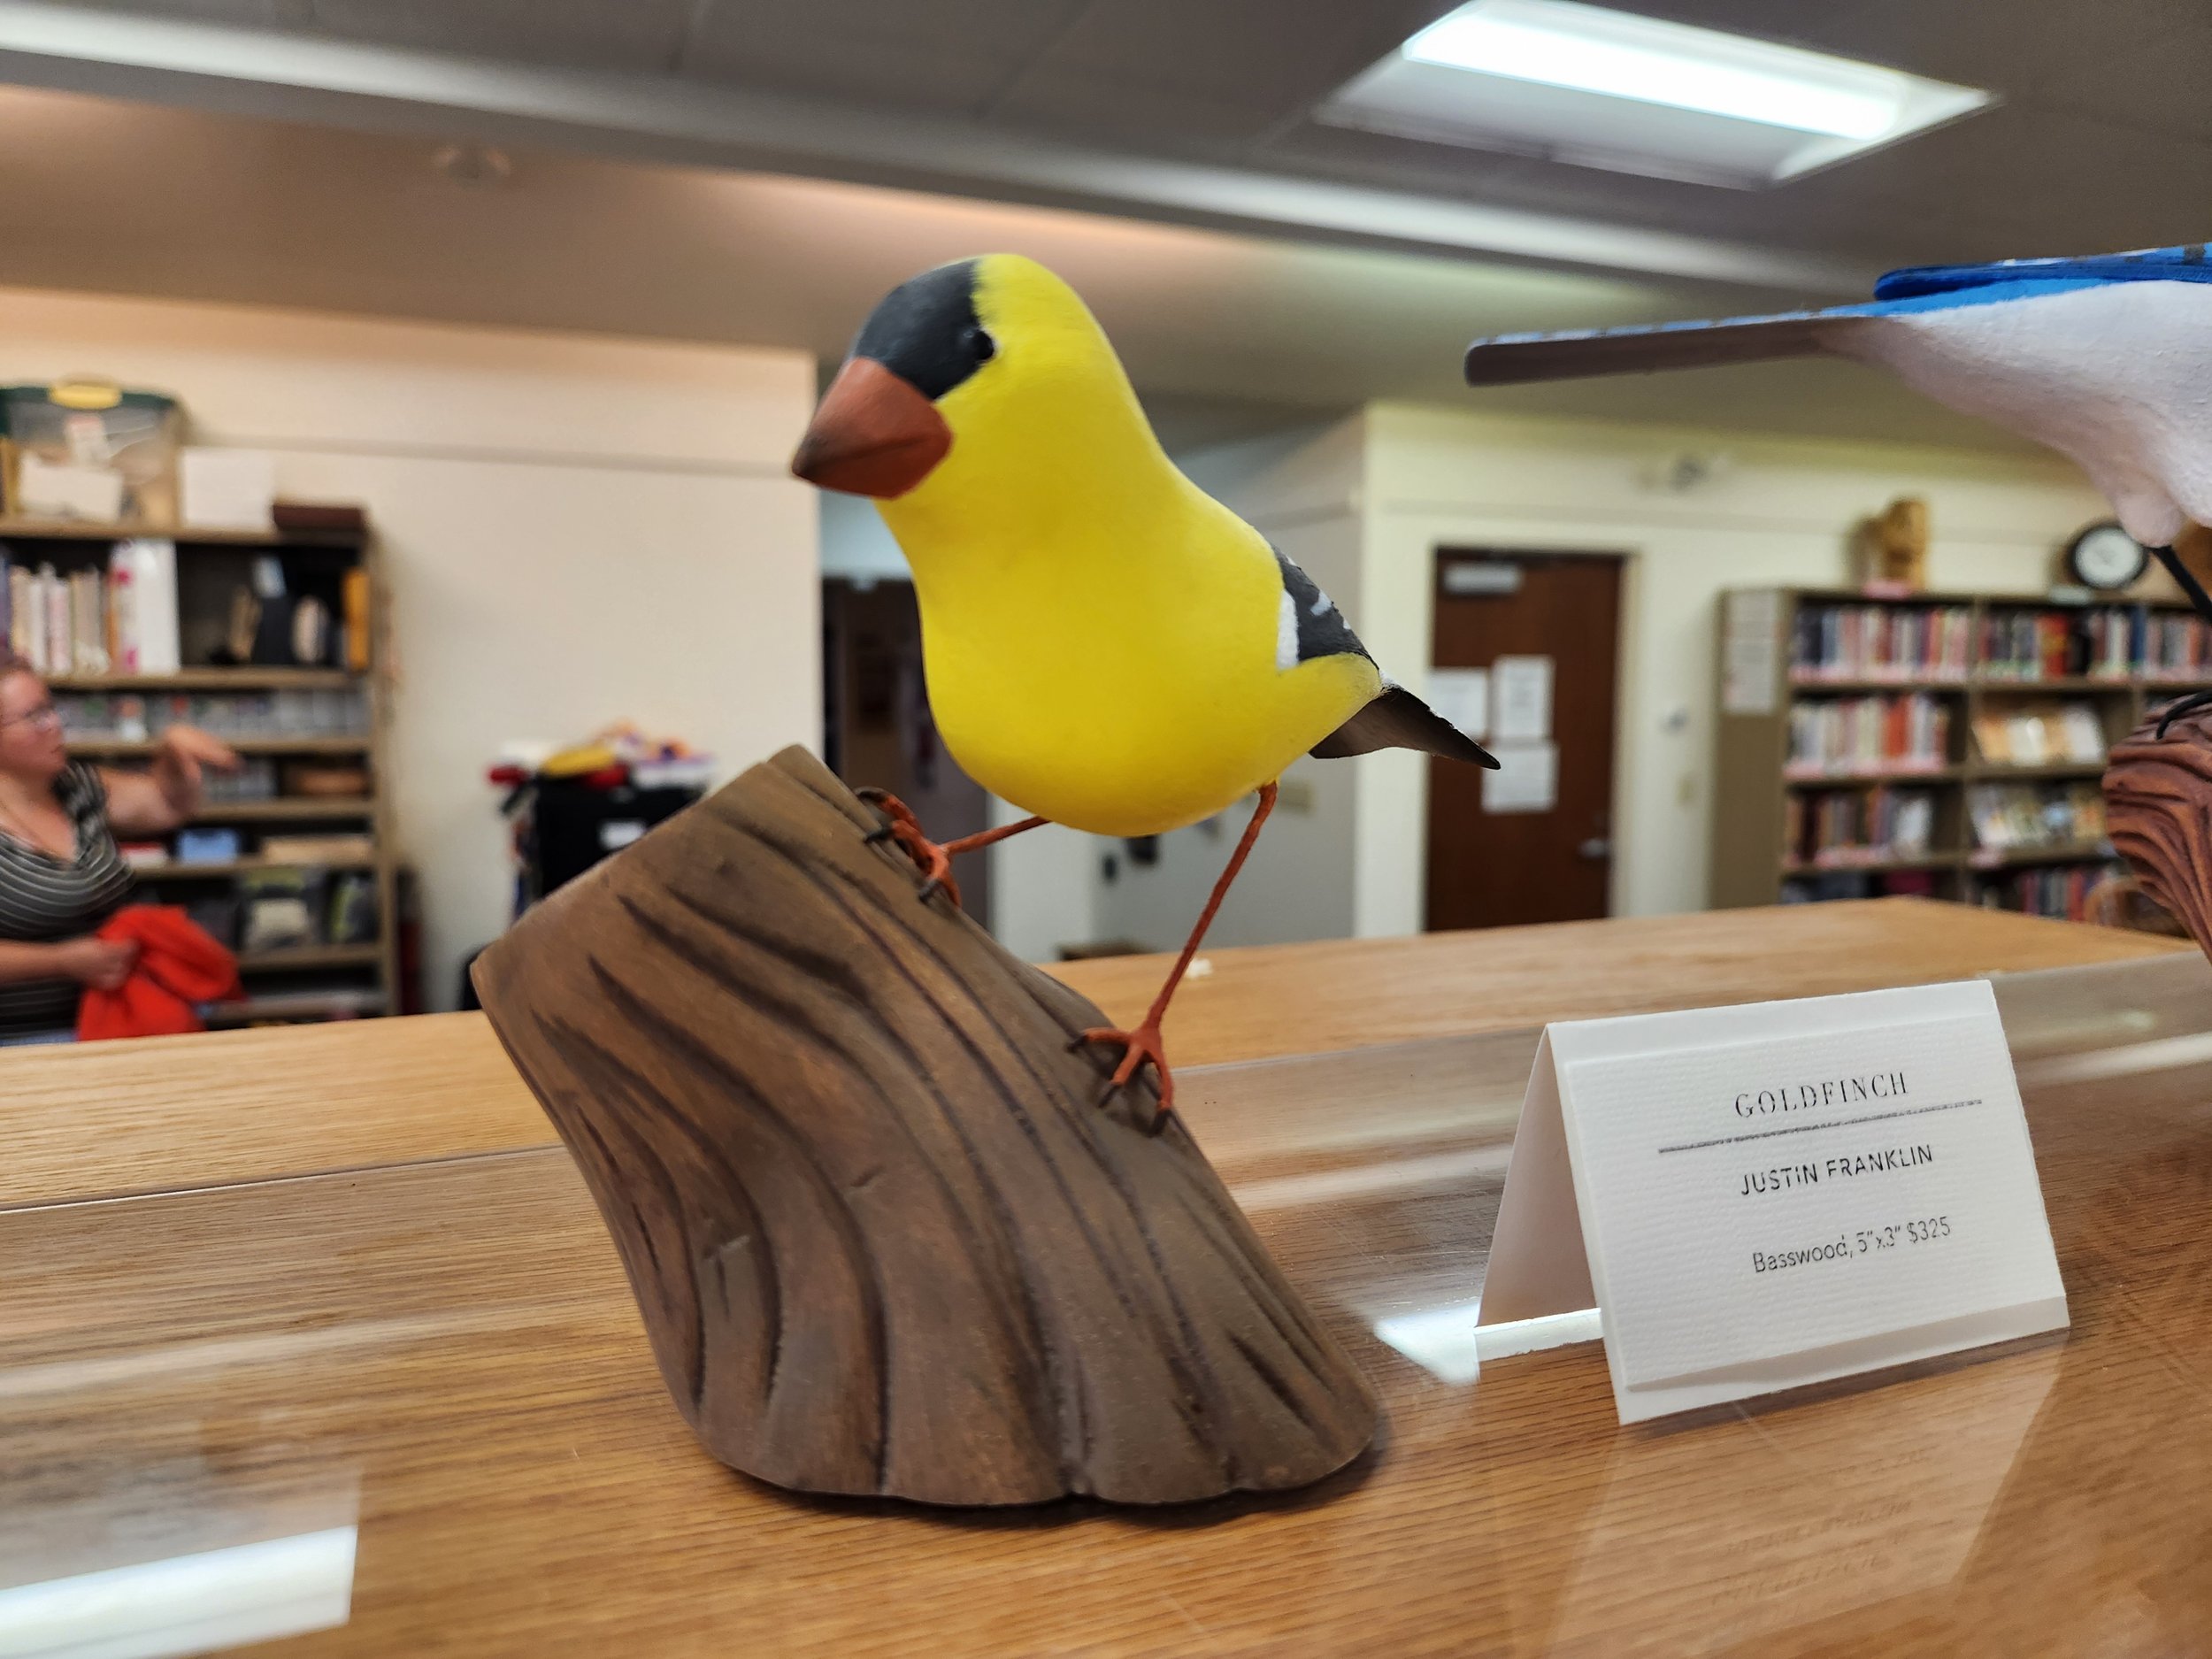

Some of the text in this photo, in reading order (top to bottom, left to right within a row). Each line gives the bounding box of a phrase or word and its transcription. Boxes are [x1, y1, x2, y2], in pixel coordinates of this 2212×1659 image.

[1734, 1071, 1909, 1118] GOLDFINCH
[1740, 1144, 1933, 1196] JUSTIN FRANKLIN
[1752, 1234, 1854, 1273] Basswood,
[1906, 1216, 1951, 1244] $325
